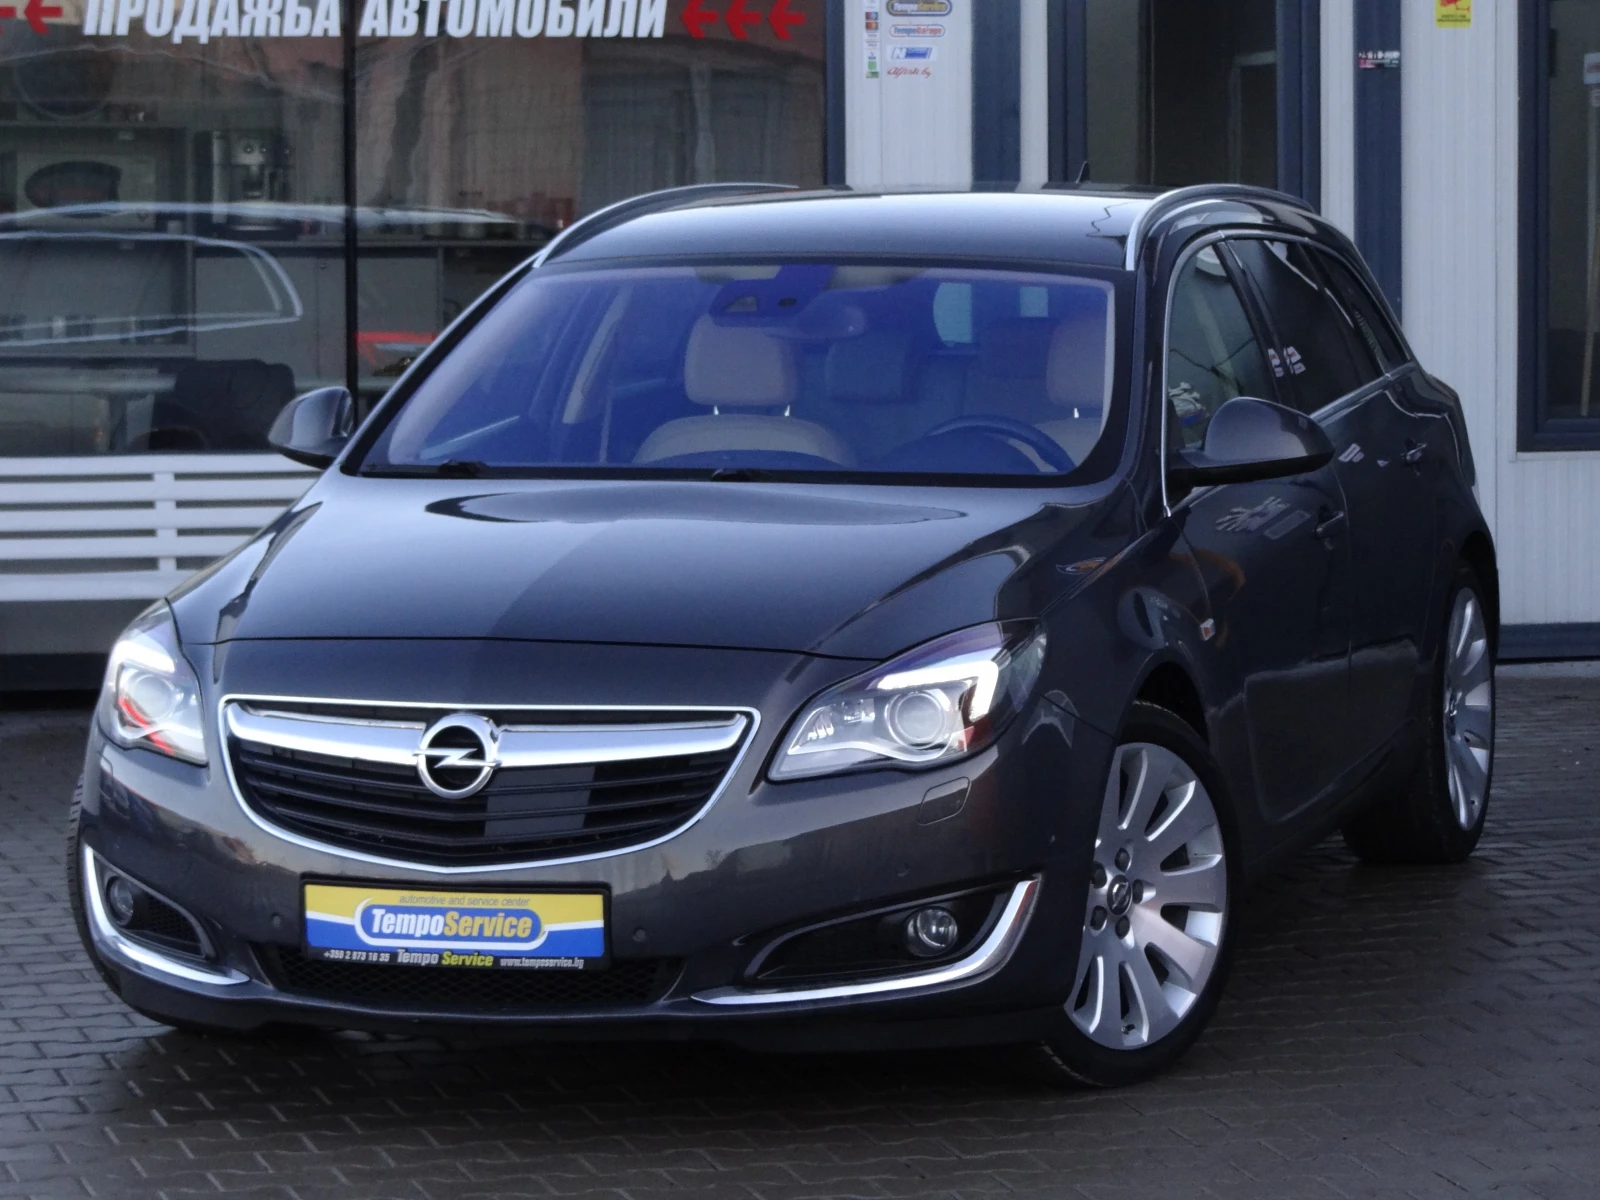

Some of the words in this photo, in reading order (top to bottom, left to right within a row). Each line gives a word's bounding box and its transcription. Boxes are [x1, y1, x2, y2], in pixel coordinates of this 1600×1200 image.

[358, 0, 668, 39] АВТОМОБИЛИ
[399, 895, 446, 905] automotive
[448, 896, 465, 905] and
[467, 897, 499, 906] service
[502, 897, 530, 907] center
[371, 908, 533, 937] TempoService
[396, 948, 440, 966] Tempo
[441, 950, 494, 967] Service
[499, 956, 585, 969] www.temposervice.bg
